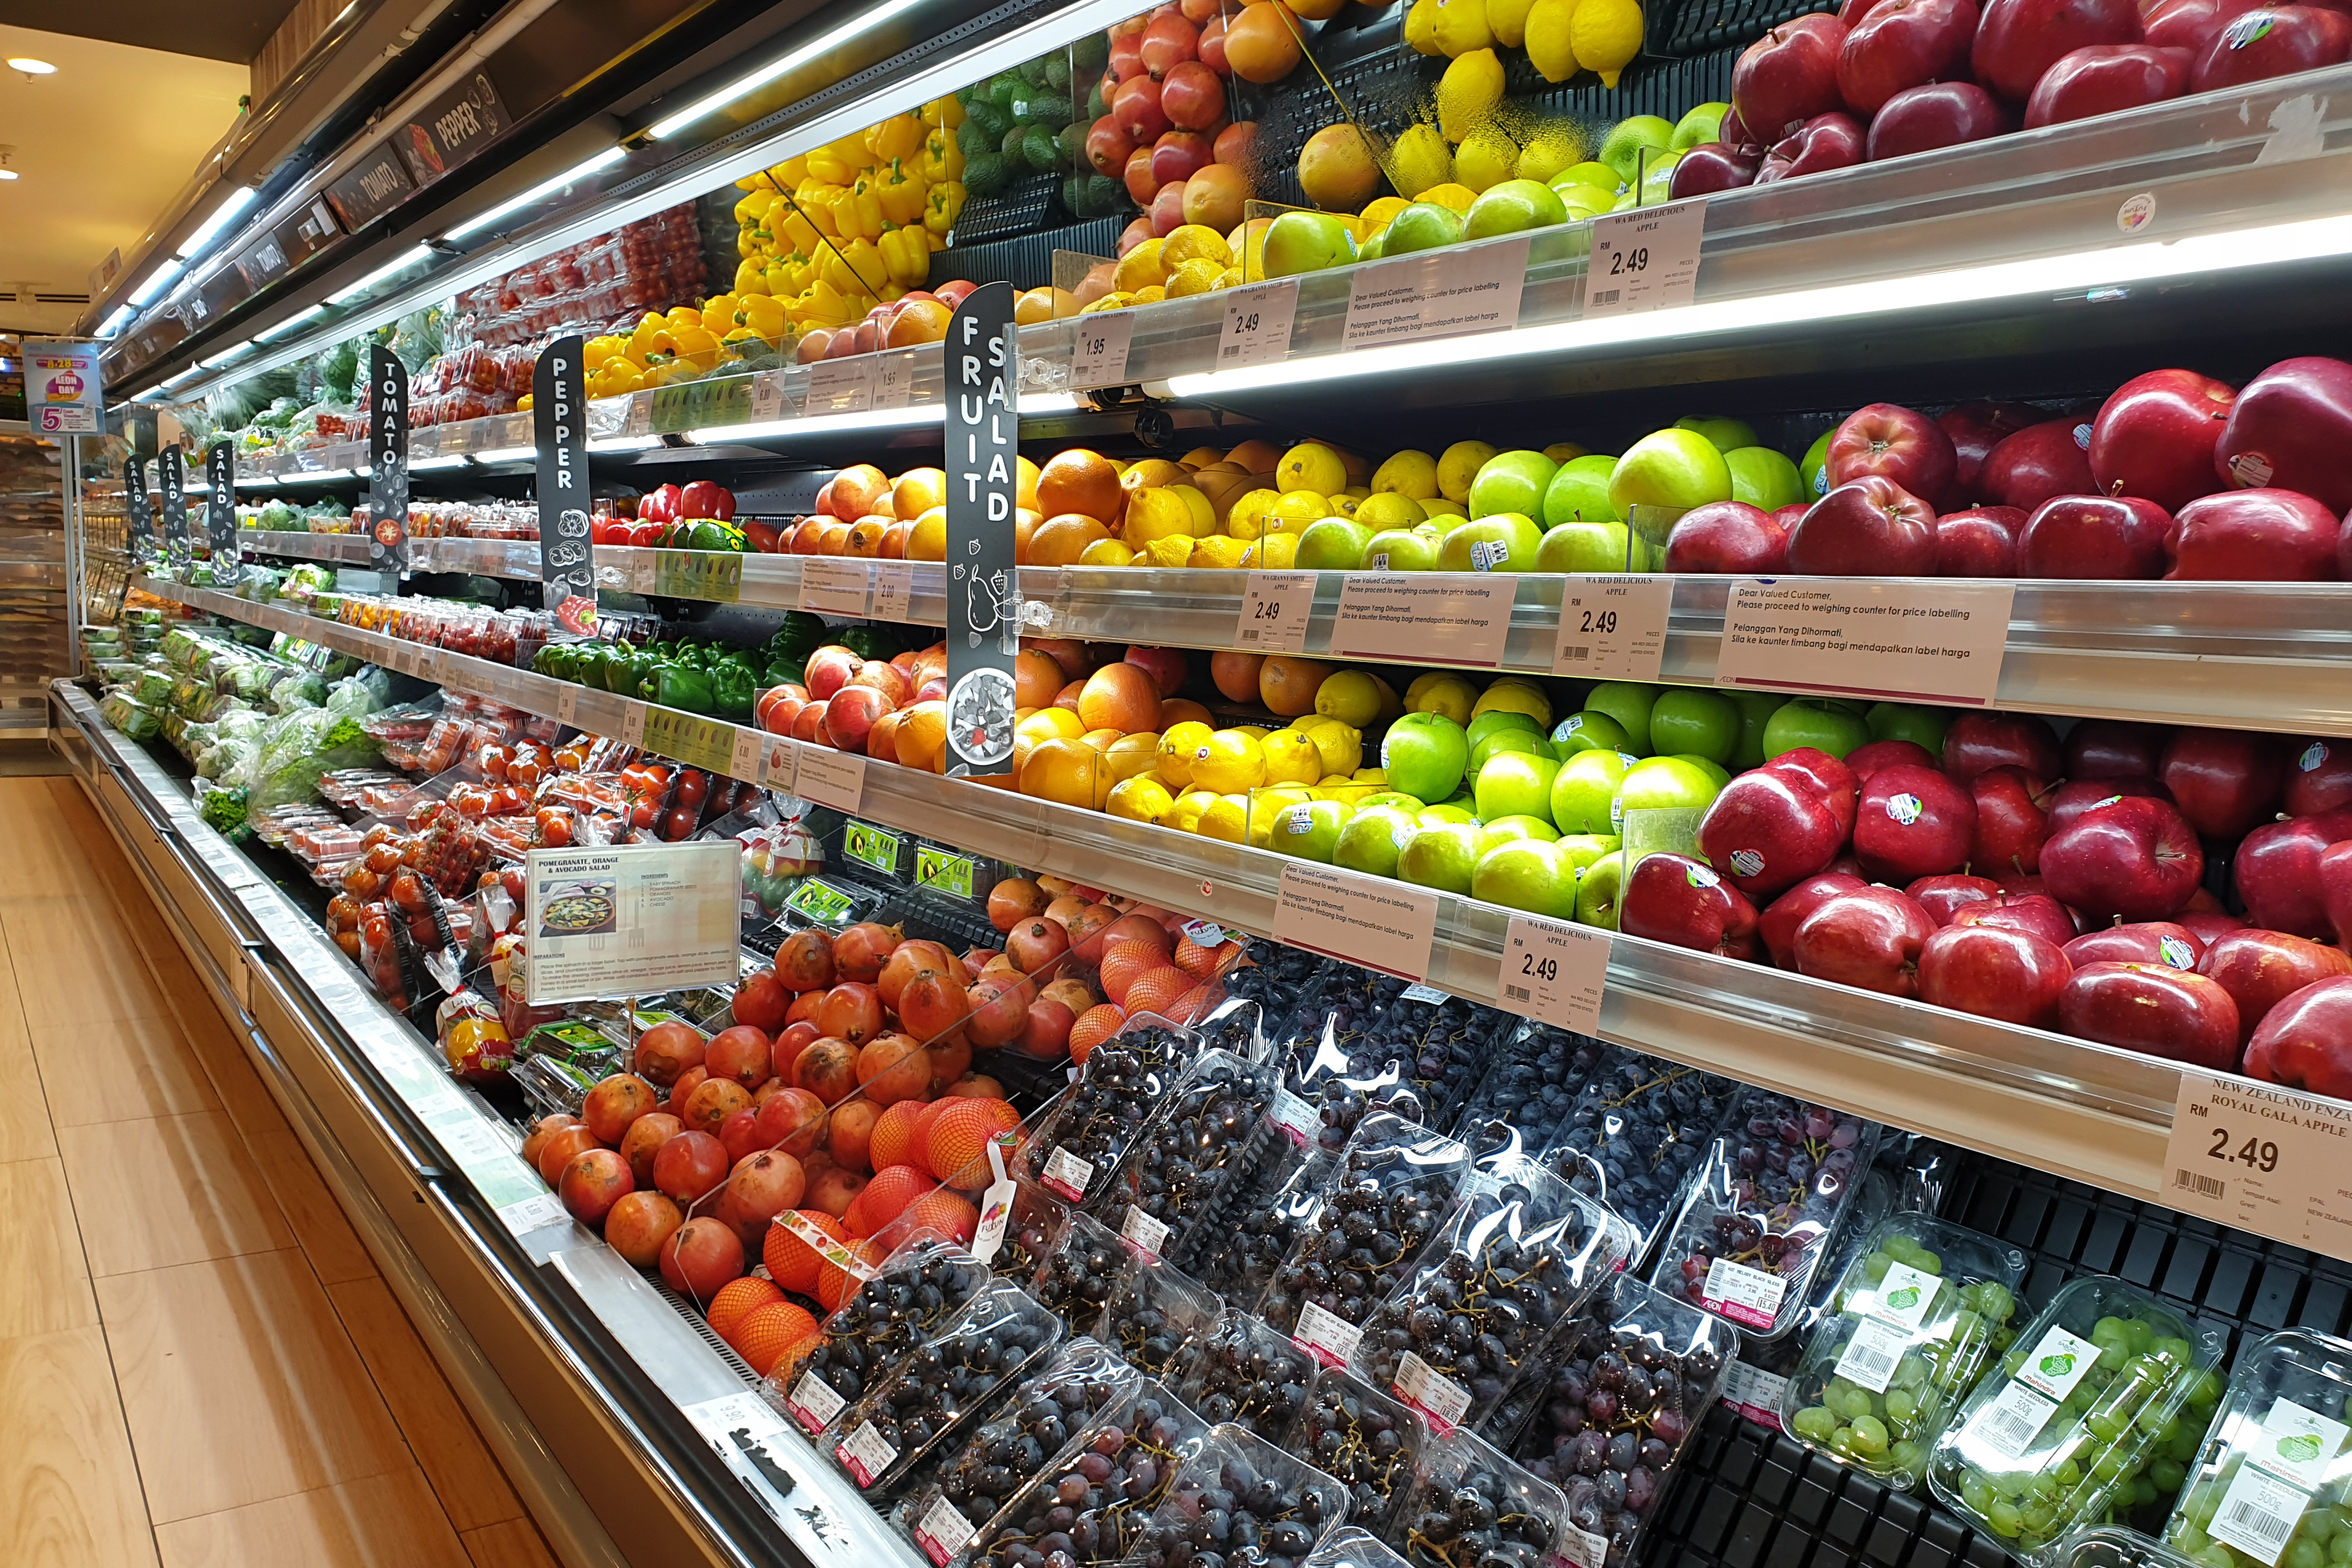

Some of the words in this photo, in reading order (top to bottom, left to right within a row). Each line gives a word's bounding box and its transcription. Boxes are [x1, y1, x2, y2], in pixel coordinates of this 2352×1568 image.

[436, 102, 481, 151] PEPPER
[359, 162, 398, 203] TOMATO
[1628, 213, 1643, 222] RED
[1644, 206, 1685, 219] DELICIOUS
[1636, 222, 1659, 232] APPLE
[1600, 242, 1610, 250] RM
[1610, 248, 1648, 275] 2.49
[1235, 313, 1259, 334] 2.49
[1087, 338, 1105, 355] 1.95
[58, 386, 75, 394] DAY
[41, 407, 61, 431] 5
[382, 363, 397, 464] TOMATO
[961, 316, 983, 502] FRUIT
[552, 358, 572, 488] PEPPER
[987, 337, 1009, 522] SALAD
[130, 461, 141, 502] SALAD
[166, 452, 177, 500] SALAD
[216, 449, 227, 505] SALAD
[881, 584, 894, 598] 2.00
[1394, 587, 1418, 596] weighing
[1465, 589, 1490, 597] labelling
[1791, 591, 1831, 600] Customer,
[1255, 601, 1279, 620] 2.49
[1737, 600, 1762, 608] Please
[1812, 604, 1850, 614] weighing
[1889, 607, 1901, 615] for
[1903, 608, 1926, 617] price
[1929, 608, 1969, 620] labelling
[1580, 611, 1616, 633] 2.49
[1734, 624, 1776, 635] Pelanggan
[1779, 626, 1799, 636] Yang
[1801, 627, 1842, 638] Dihormati,
[1759, 636, 1789, 645] kaunter
[1791, 638, 1825, 650] timbang
[1828, 640, 1847, 651] bagi
[1850, 643, 1913, 653] mendapatkan
[1915, 646, 1939, 655] label
[1942, 648, 1970, 659] harga
[739, 746, 749, 758] 6.80
[538, 859, 590, 867] POMEGRANATE,
[1299, 867, 1315, 876] Valued
[1283, 891, 1307, 902] Pelanggan
[1309, 897, 1320, 907] Yang
[1286, 874, 1300, 882] Please
[1301, 879, 1321, 887] proceed
[1328, 885, 1349, 895] weighing
[1392, 899, 1414, 911] labelling
[1297, 903, 1314, 912] kaunter
[1315, 908, 1335, 919] timbang
[1336, 914, 1347, 922] bagi
[1348, 918, 1382, 930] mendapatkan
[1384, 926, 1396, 935] label
[1398, 930, 1413, 940] harga
[1528, 919, 1538, 928] WA
[1539, 922, 1553, 932] RED
[1555, 926, 1592, 942] DELICIOUS
[1514, 939, 1522, 947] RM
[1546, 936, 1567, 947] APPLE
[1522, 953, 1557, 981] 2.49
[2190, 1103, 2208, 1118] RM
[2212, 1079, 2243, 1093] NEW
[2246, 1087, 2311, 1111] ZEALAND
[2315, 1104, 2352, 1122] ENZA
[2211, 1094, 2256, 1115] ROYAL
[2260, 1107, 2298, 1125] GALA
[2302, 1119, 2347, 1138] APPLE
[2207, 1128, 2278, 1172] 2.49
[2309, 1196, 2325, 1206] EPAL
[1759, 1299, 1776, 1311] 15.40
[1870, 1335, 1888, 1350] 500g
[2057, 1340, 2080, 1354] SABORO
[2014, 1384, 2028, 1395] WHITE
[2028, 1392, 2049, 1407] SEEDLESS
[2014, 1399, 2032, 1416] 500g
[2293, 1419, 2324, 1435] SABORO
[2250, 1471, 2270, 1485] WHITE
[2272, 1480, 2302, 1500] SEEDLESS
[2257, 1491, 2282, 1511] 500g
